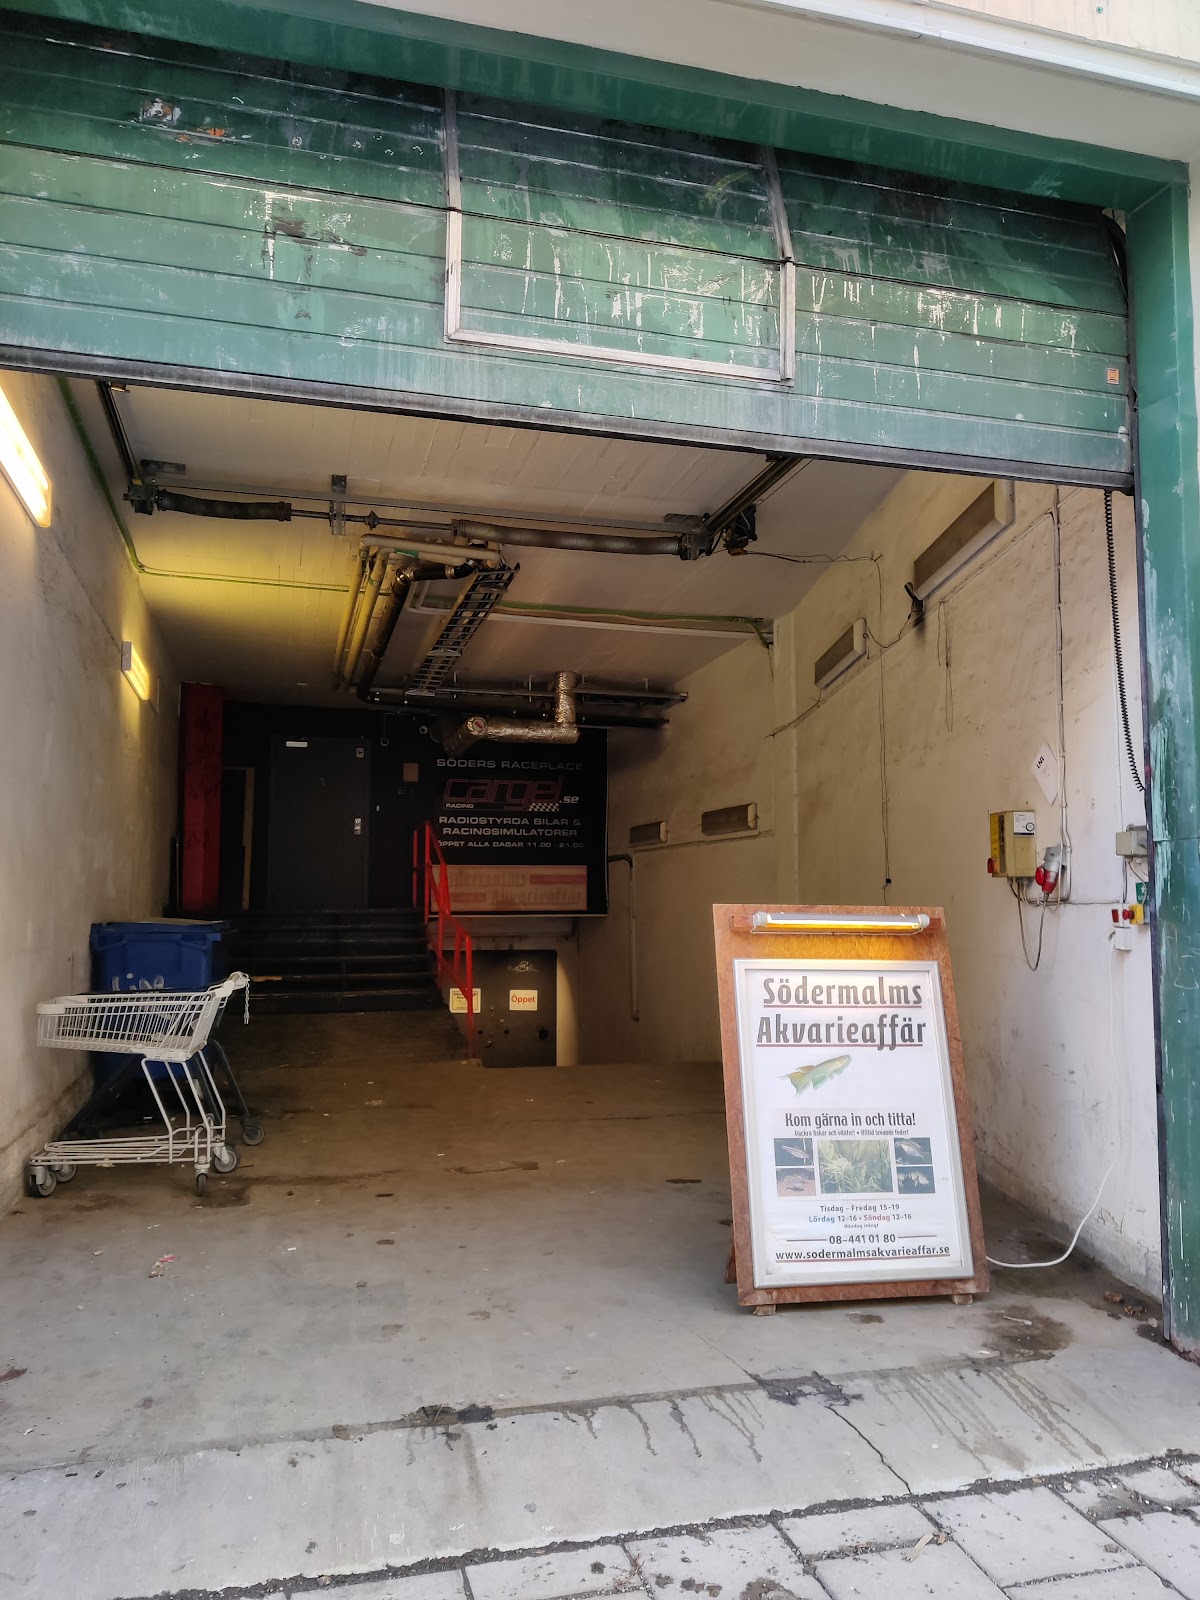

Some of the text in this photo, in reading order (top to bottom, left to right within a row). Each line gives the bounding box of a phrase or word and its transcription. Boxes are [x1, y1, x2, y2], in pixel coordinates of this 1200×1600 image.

[436, 757, 584, 771] SÖDERS RACEPLACE
[438, 816, 581, 826] RADIOSTYRDA BILAR &
[442, 827, 578, 837] RACINGSIMULATORER
[763, 975, 923, 1005] Södermalms
[511, 994, 536, 1004] Öppet
[756, 1013, 927, 1051] Akvarieaffär
[785, 1112, 916, 1129] Kom gärna in och titta!
[819, 1205, 844, 1214] Tisdag
[851, 1204, 877, 1213] Fredag
[879, 1203, 900, 1211] 15-19
[808, 1212, 912, 1224] Lördag 12-16 Söndag 12-16
[828, 1233, 896, 1245] 08-441 01 80
[775, 1245, 950, 1260] www.sodermalmsakvarieaffar.se
